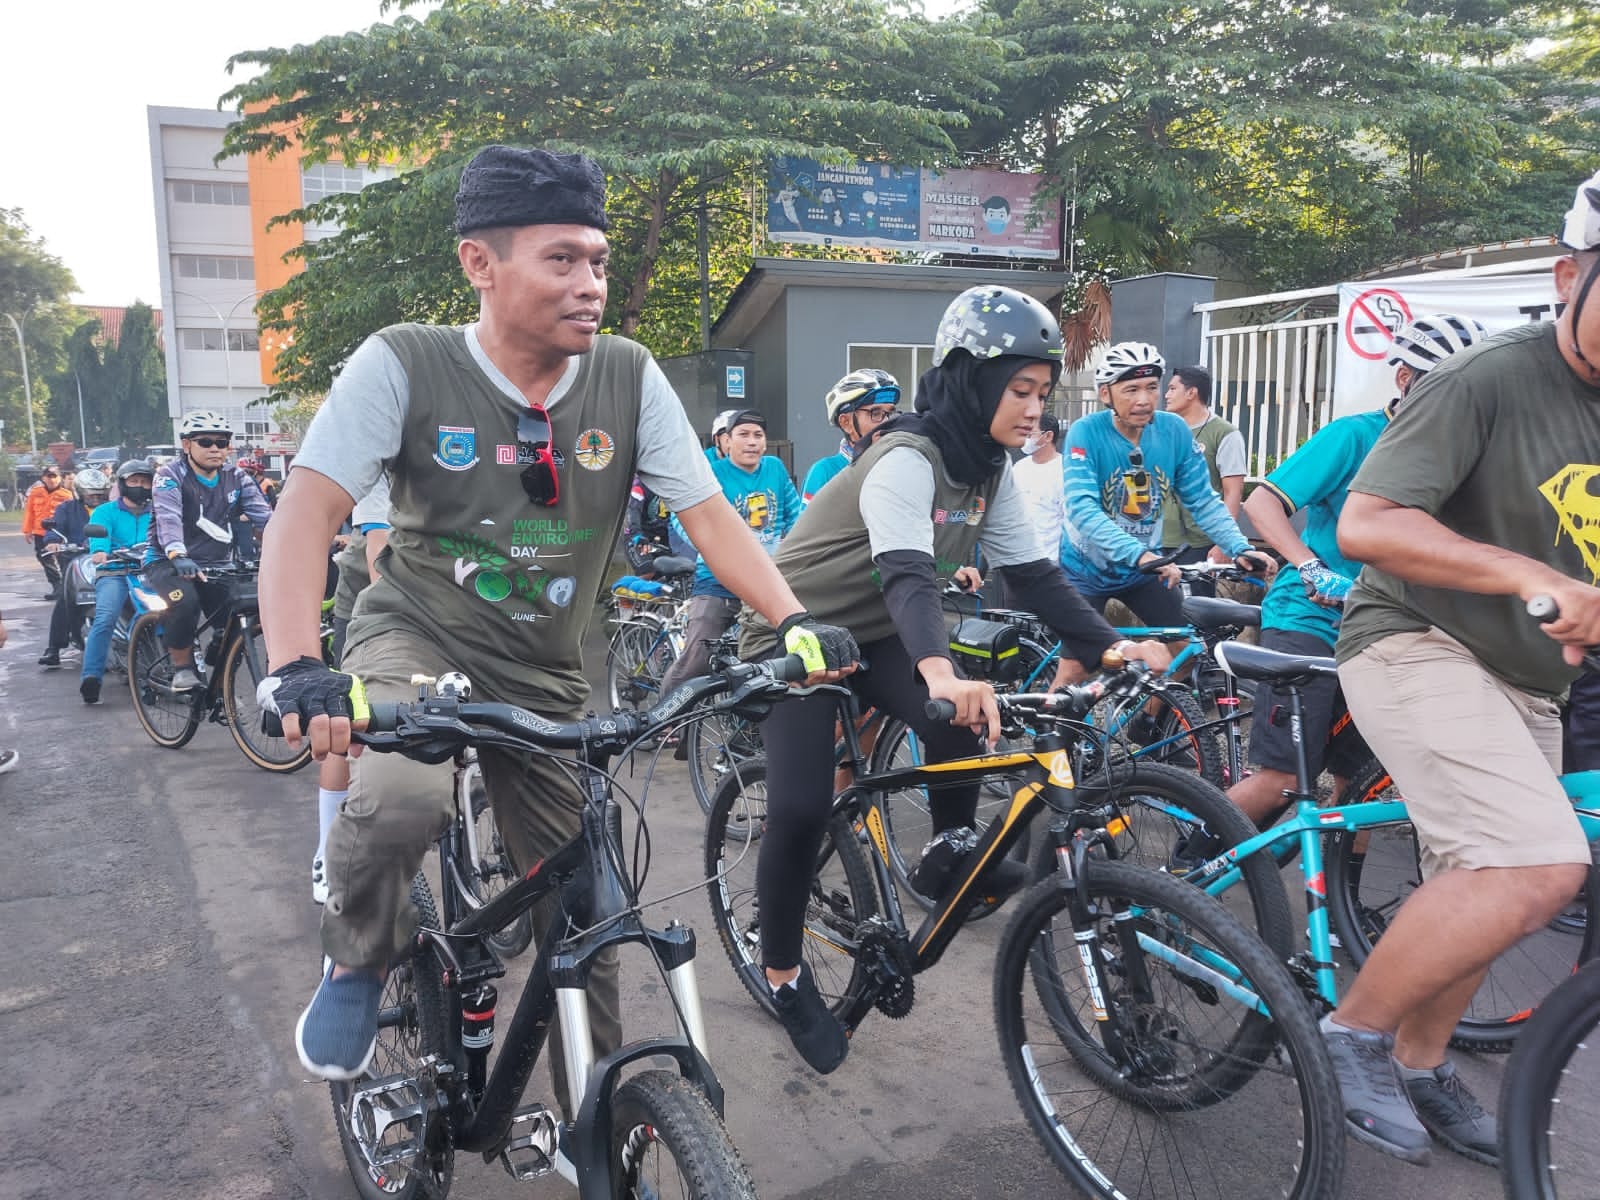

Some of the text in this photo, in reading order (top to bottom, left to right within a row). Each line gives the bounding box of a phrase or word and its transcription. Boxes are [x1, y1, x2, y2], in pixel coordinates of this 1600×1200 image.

[925, 192, 980, 206] MASKER
[929, 224, 975, 238] NARKOBA
[513, 519, 568, 532] WORLD
[510, 546, 538, 558] DAY
[511, 611, 536, 622] JUNE
